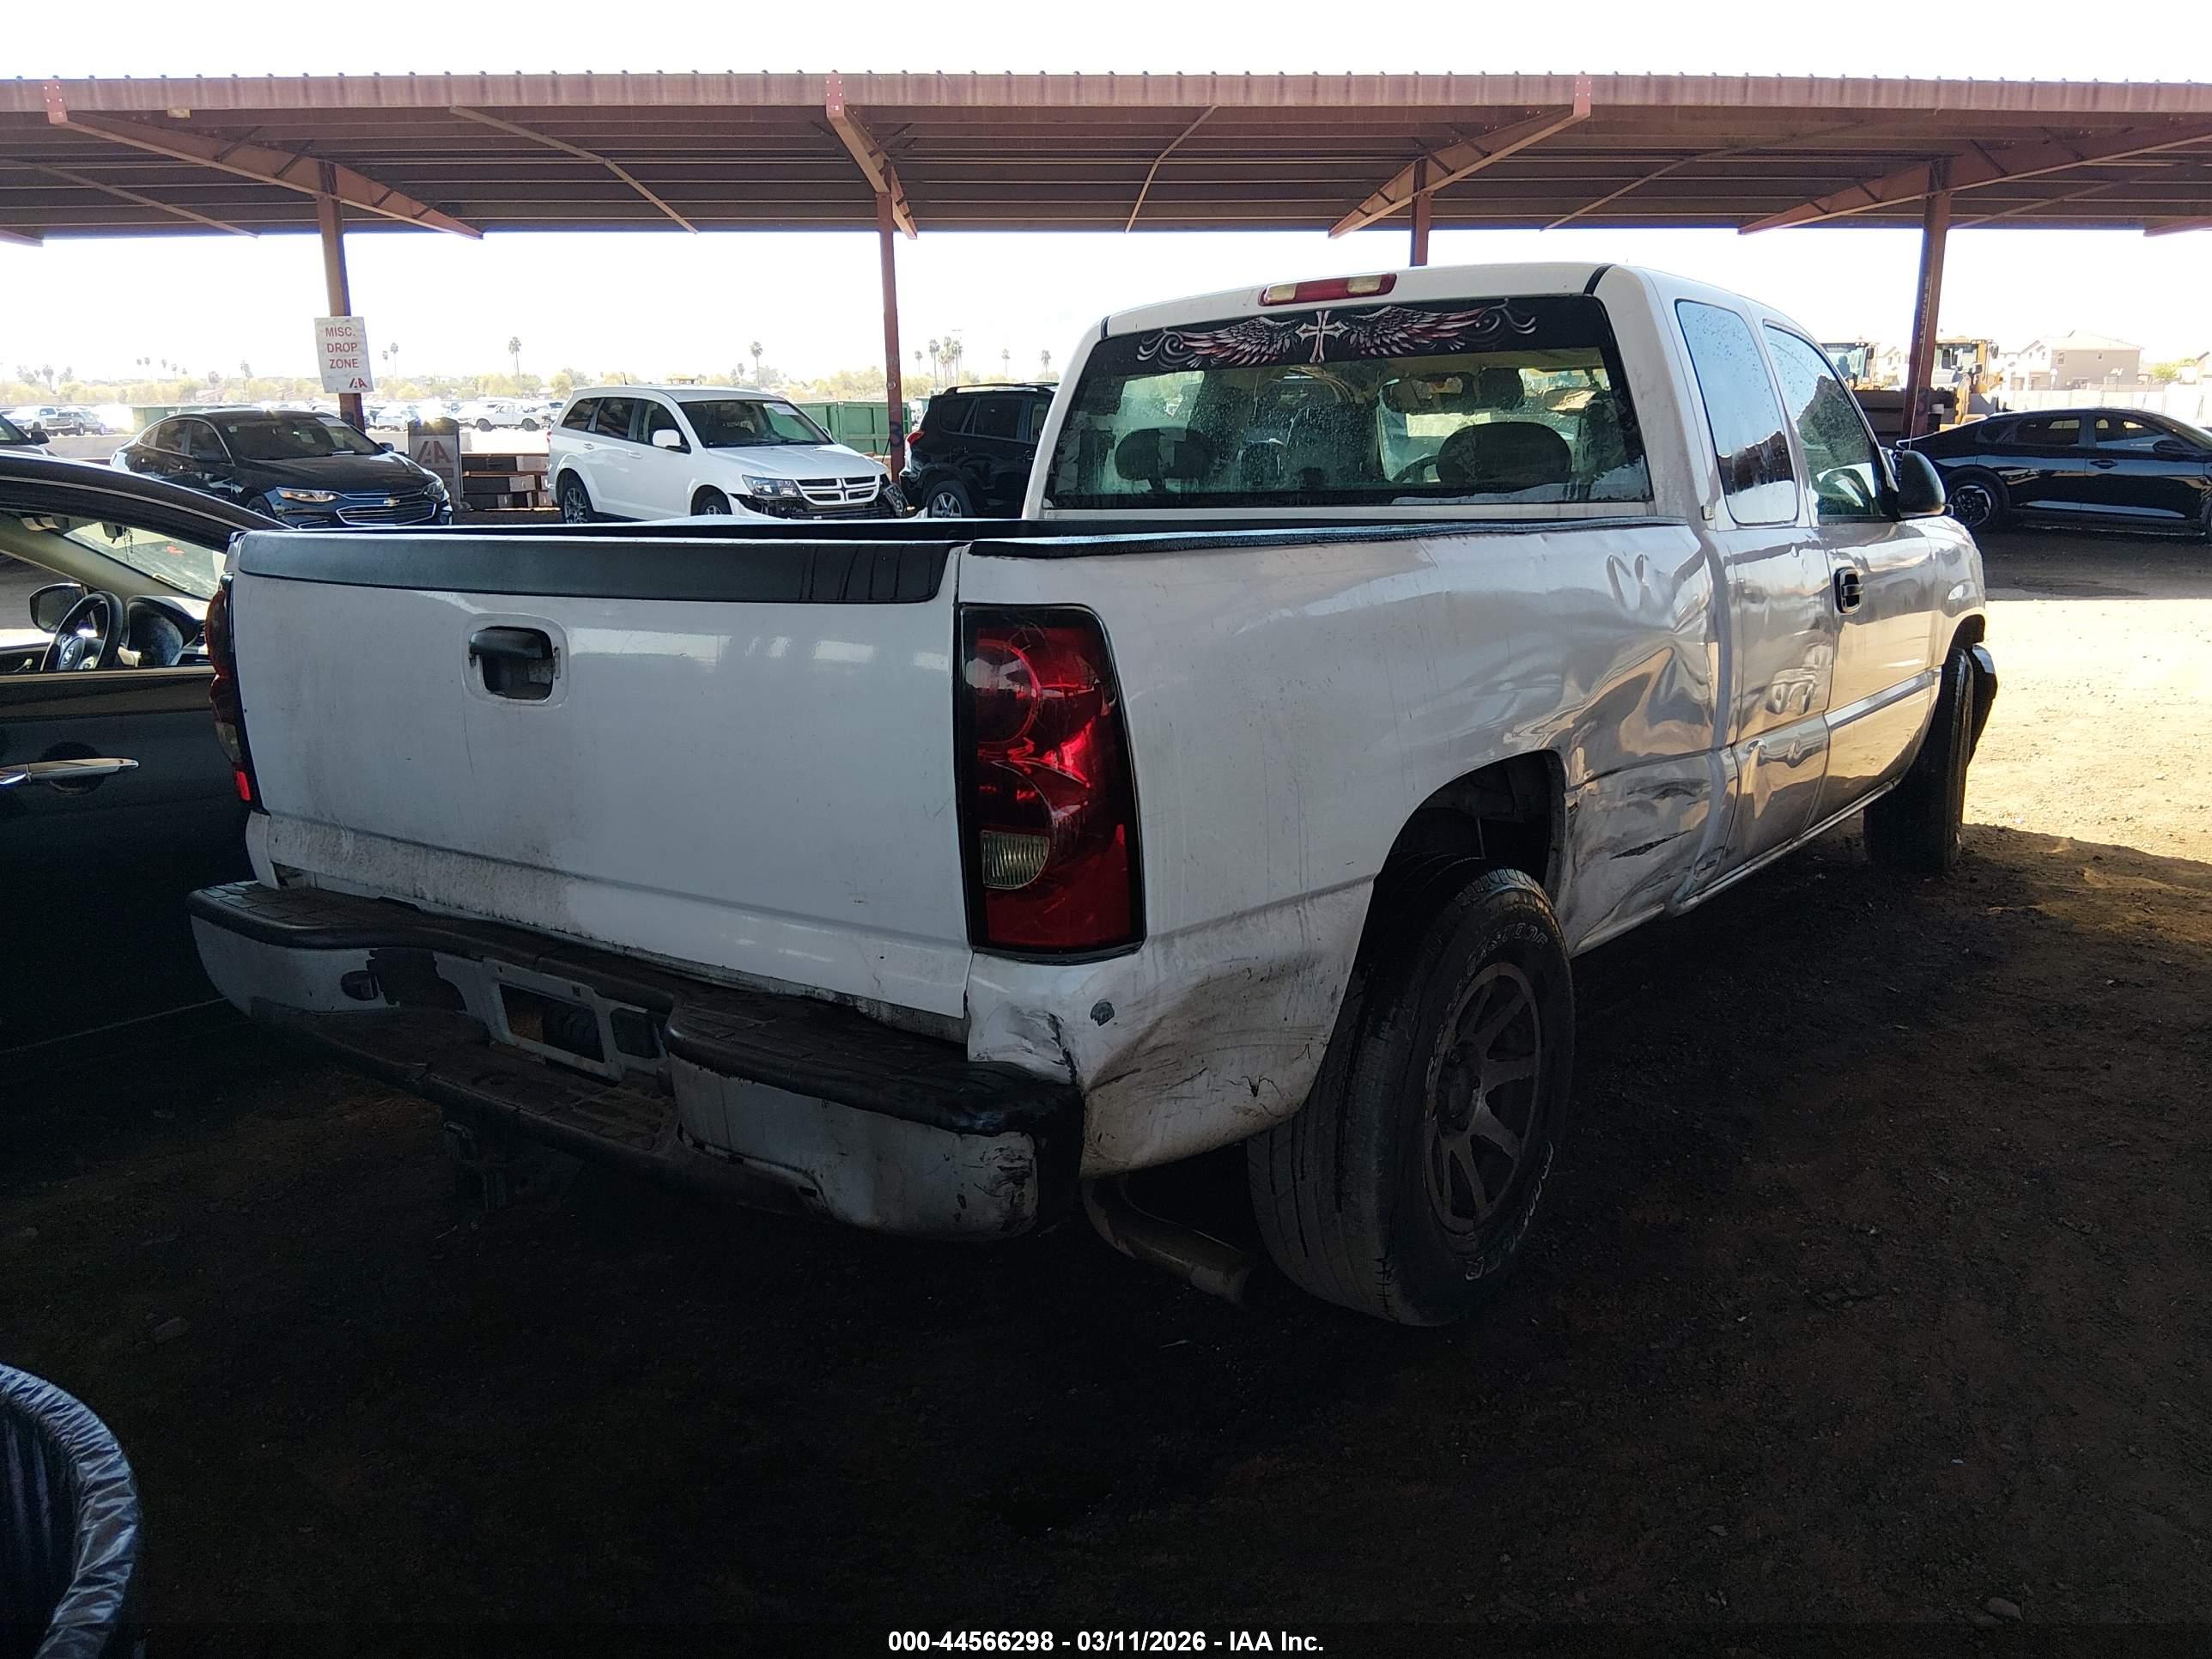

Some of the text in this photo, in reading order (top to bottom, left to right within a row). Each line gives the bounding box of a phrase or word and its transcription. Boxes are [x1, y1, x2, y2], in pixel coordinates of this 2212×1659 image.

[325, 326, 356, 337] MISC.
[326, 342, 358, 353] DROP
[329, 358, 360, 369] ZONE
